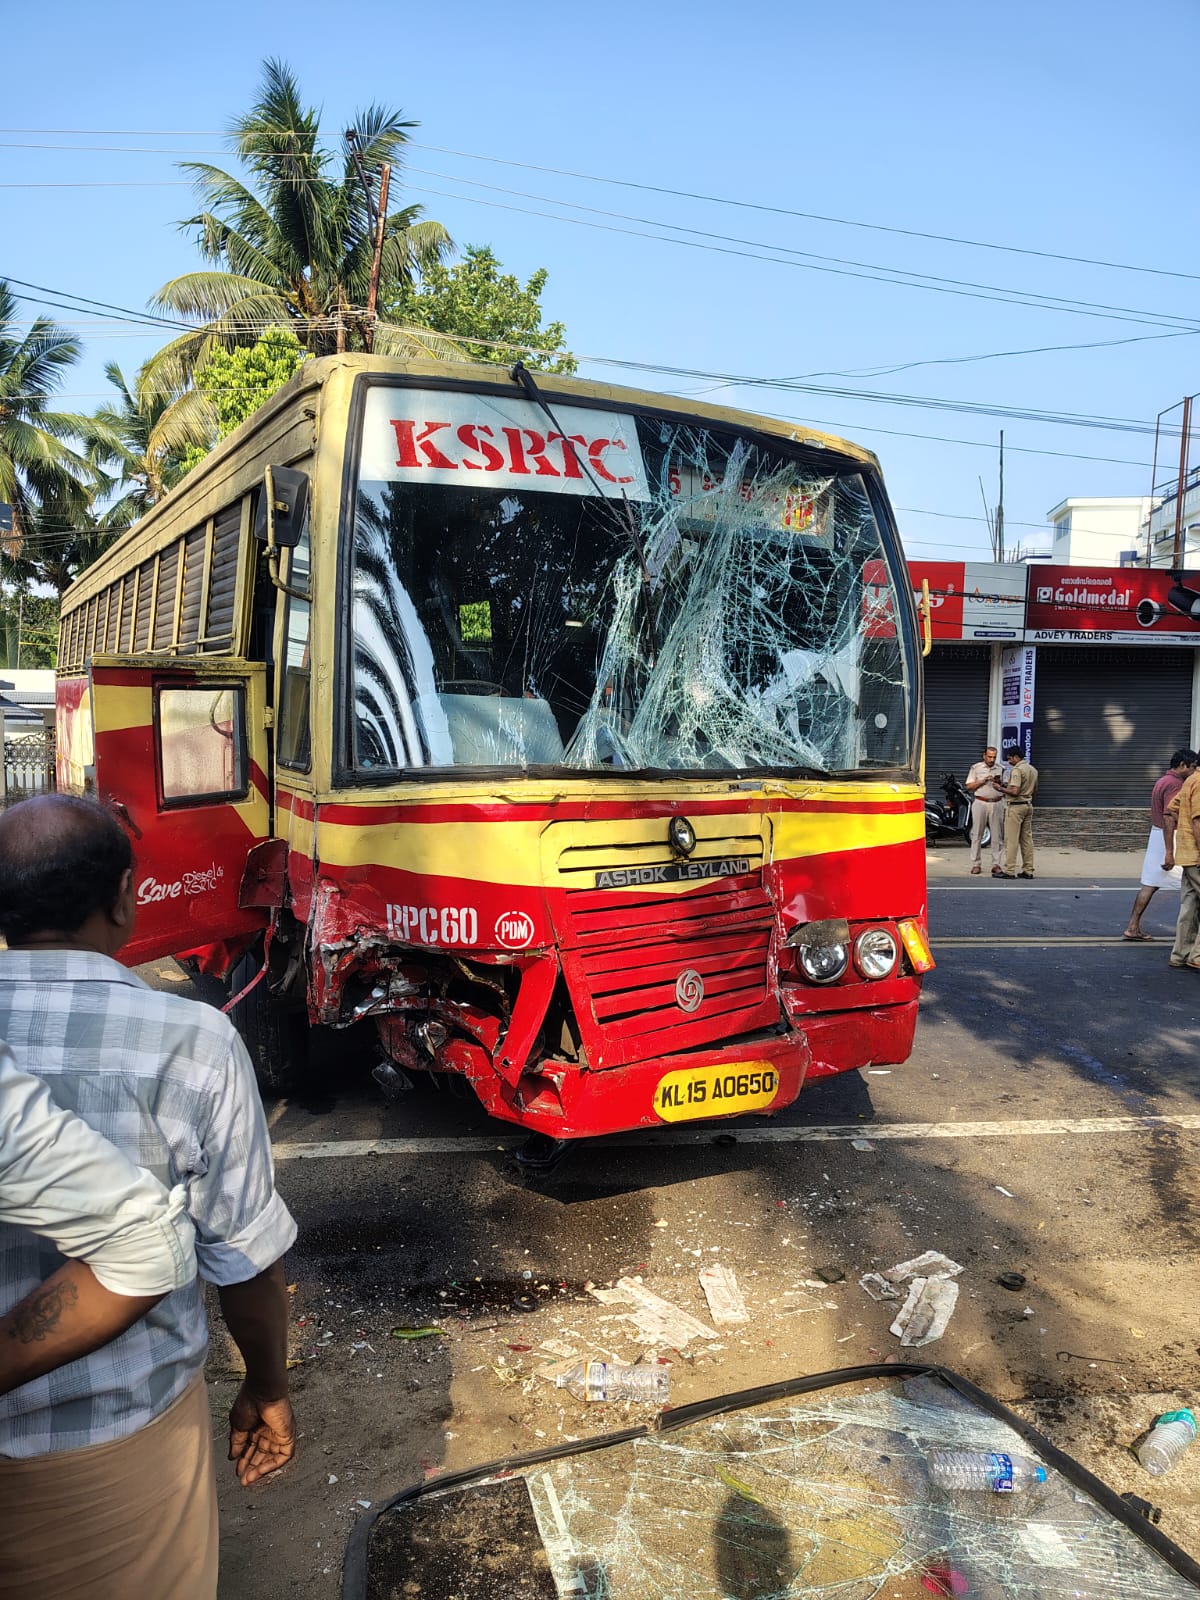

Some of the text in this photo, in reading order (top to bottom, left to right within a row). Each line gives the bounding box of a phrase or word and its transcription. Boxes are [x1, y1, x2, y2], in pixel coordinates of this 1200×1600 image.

[389, 419, 635, 484] KSRTC
[1055, 588, 1130, 606] Goldmedal
[1035, 631, 1068, 641] ADVEY
[1068, 631, 1113, 641] TRADERS
[1024, 650, 1033, 719] ADVEY TRADERS
[598, 860, 750, 888] ASHOK LEYLAND
[136, 877, 182, 905] Save
[386, 903, 478, 945] RPC60
[501, 919, 529, 941] PDM
